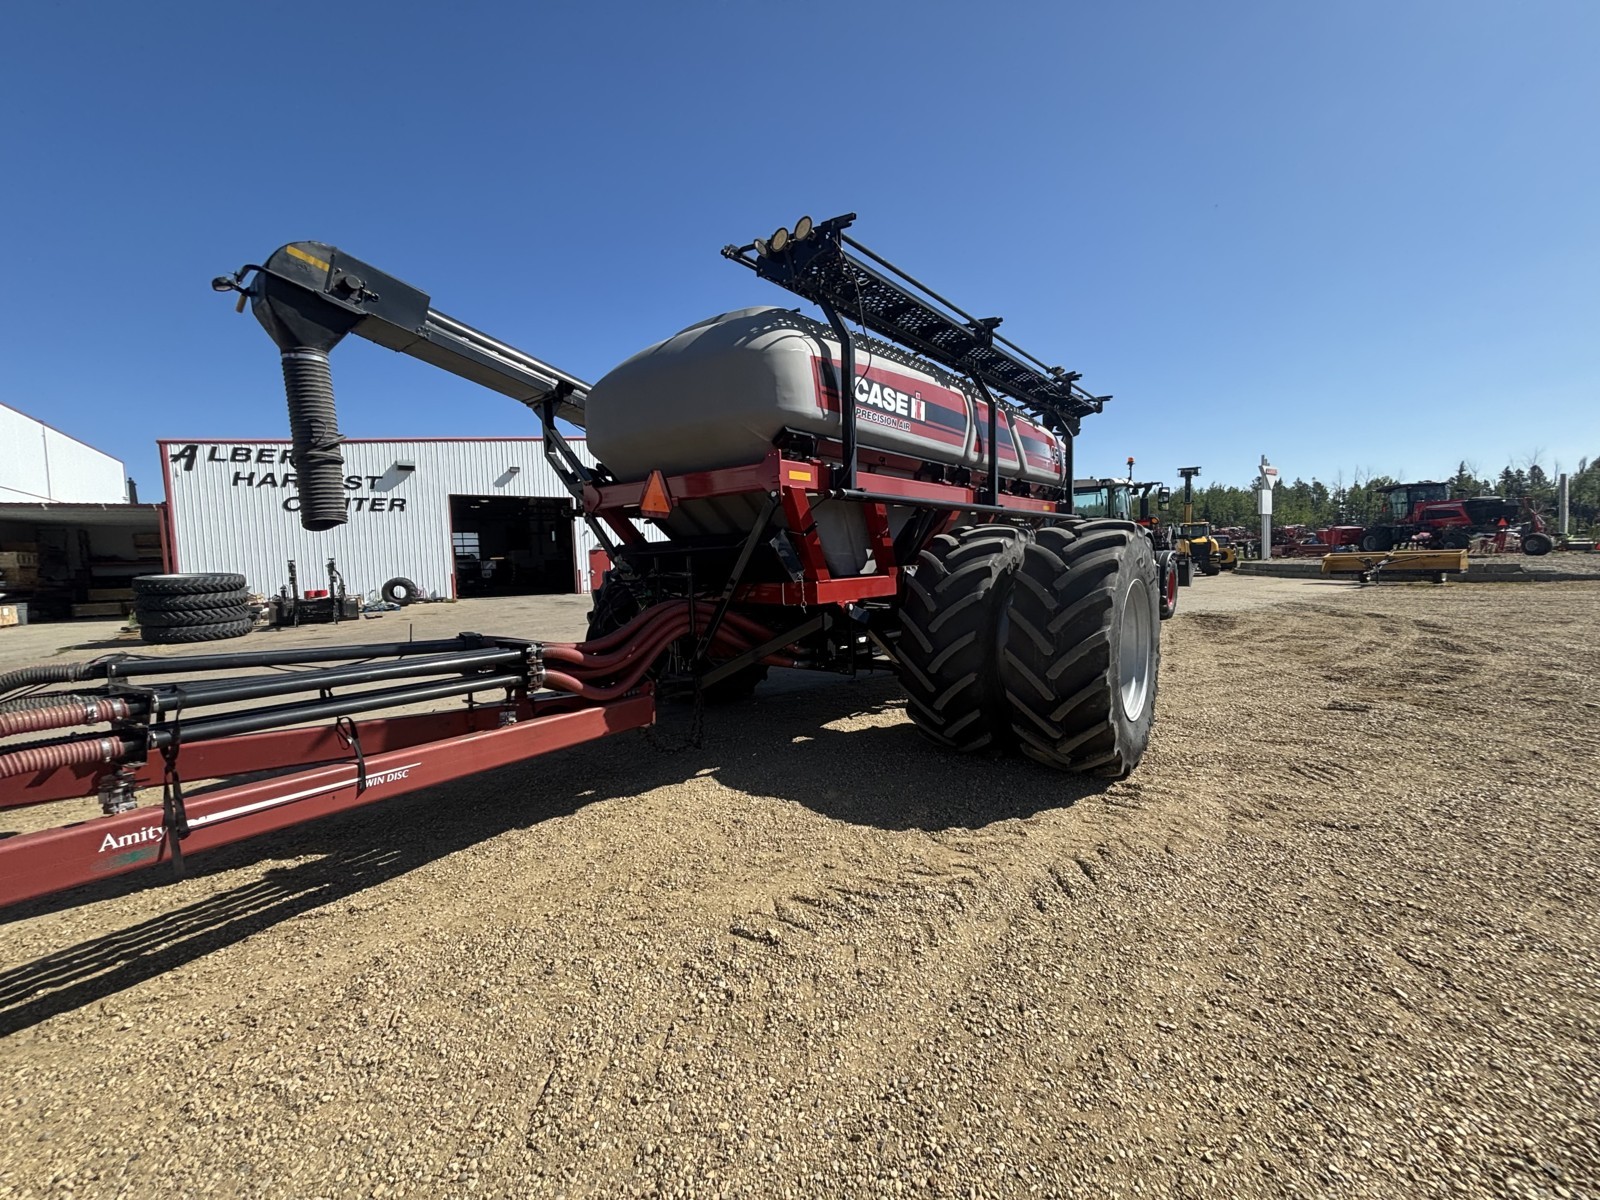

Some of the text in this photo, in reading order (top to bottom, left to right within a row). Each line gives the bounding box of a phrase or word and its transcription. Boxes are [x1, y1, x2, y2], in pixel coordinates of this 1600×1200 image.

[854, 376, 909, 416] CASE
[855, 406, 911, 432] PRECISION AIR
[386, 769, 410, 783] DISC
[98, 826, 169, 852] Amity
